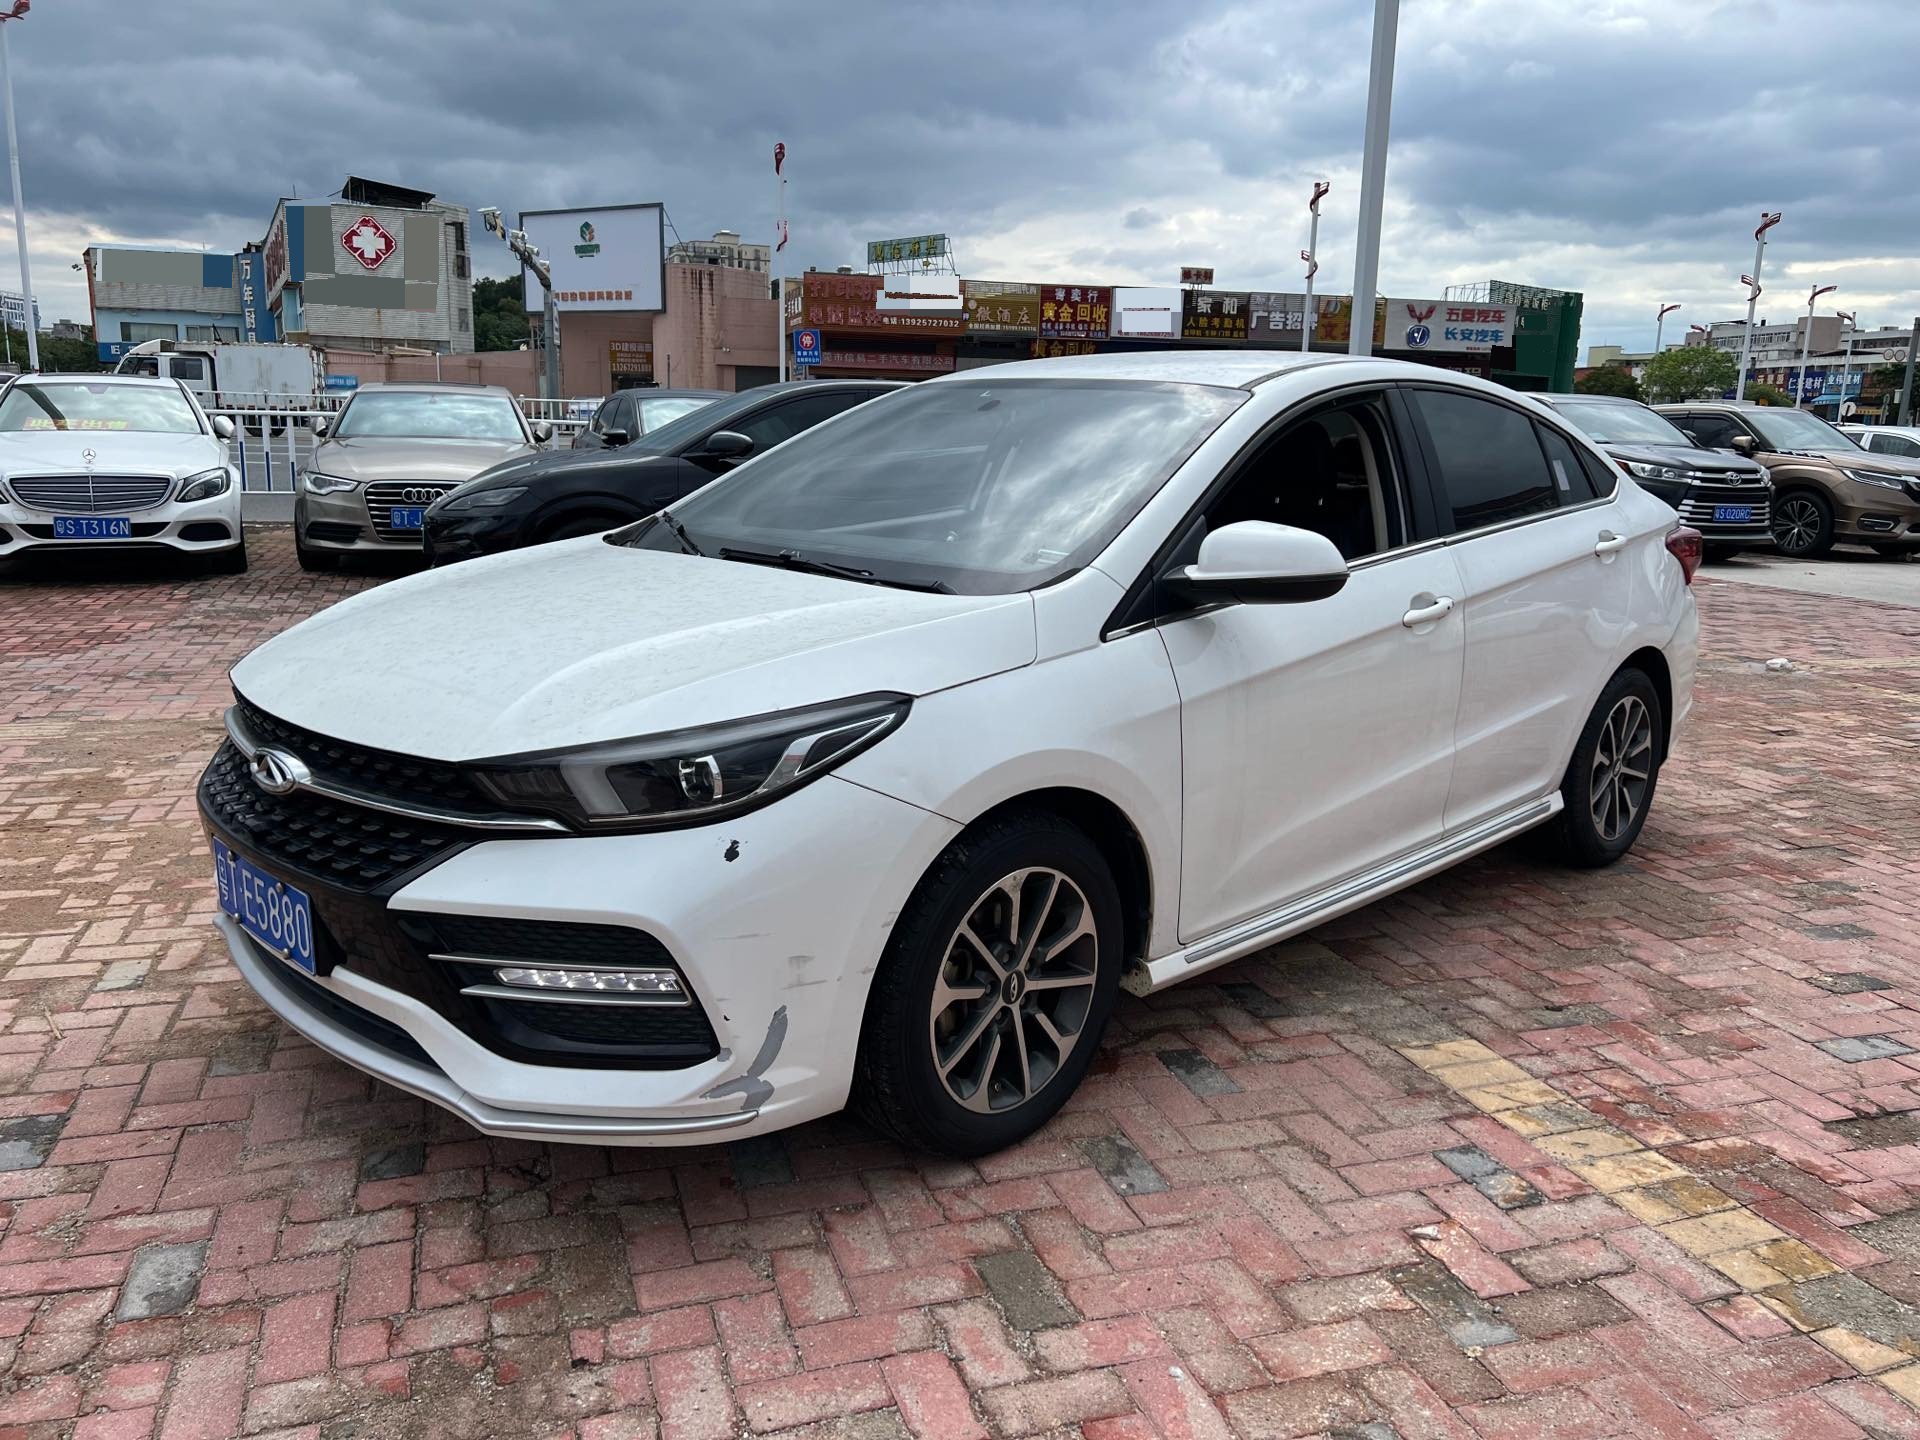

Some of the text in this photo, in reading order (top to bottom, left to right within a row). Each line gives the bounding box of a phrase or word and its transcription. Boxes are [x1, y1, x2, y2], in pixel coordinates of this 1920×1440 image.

[1042, 302, 1108, 322] 黄金回收
[1444, 327, 1505, 343] 长安汽车
